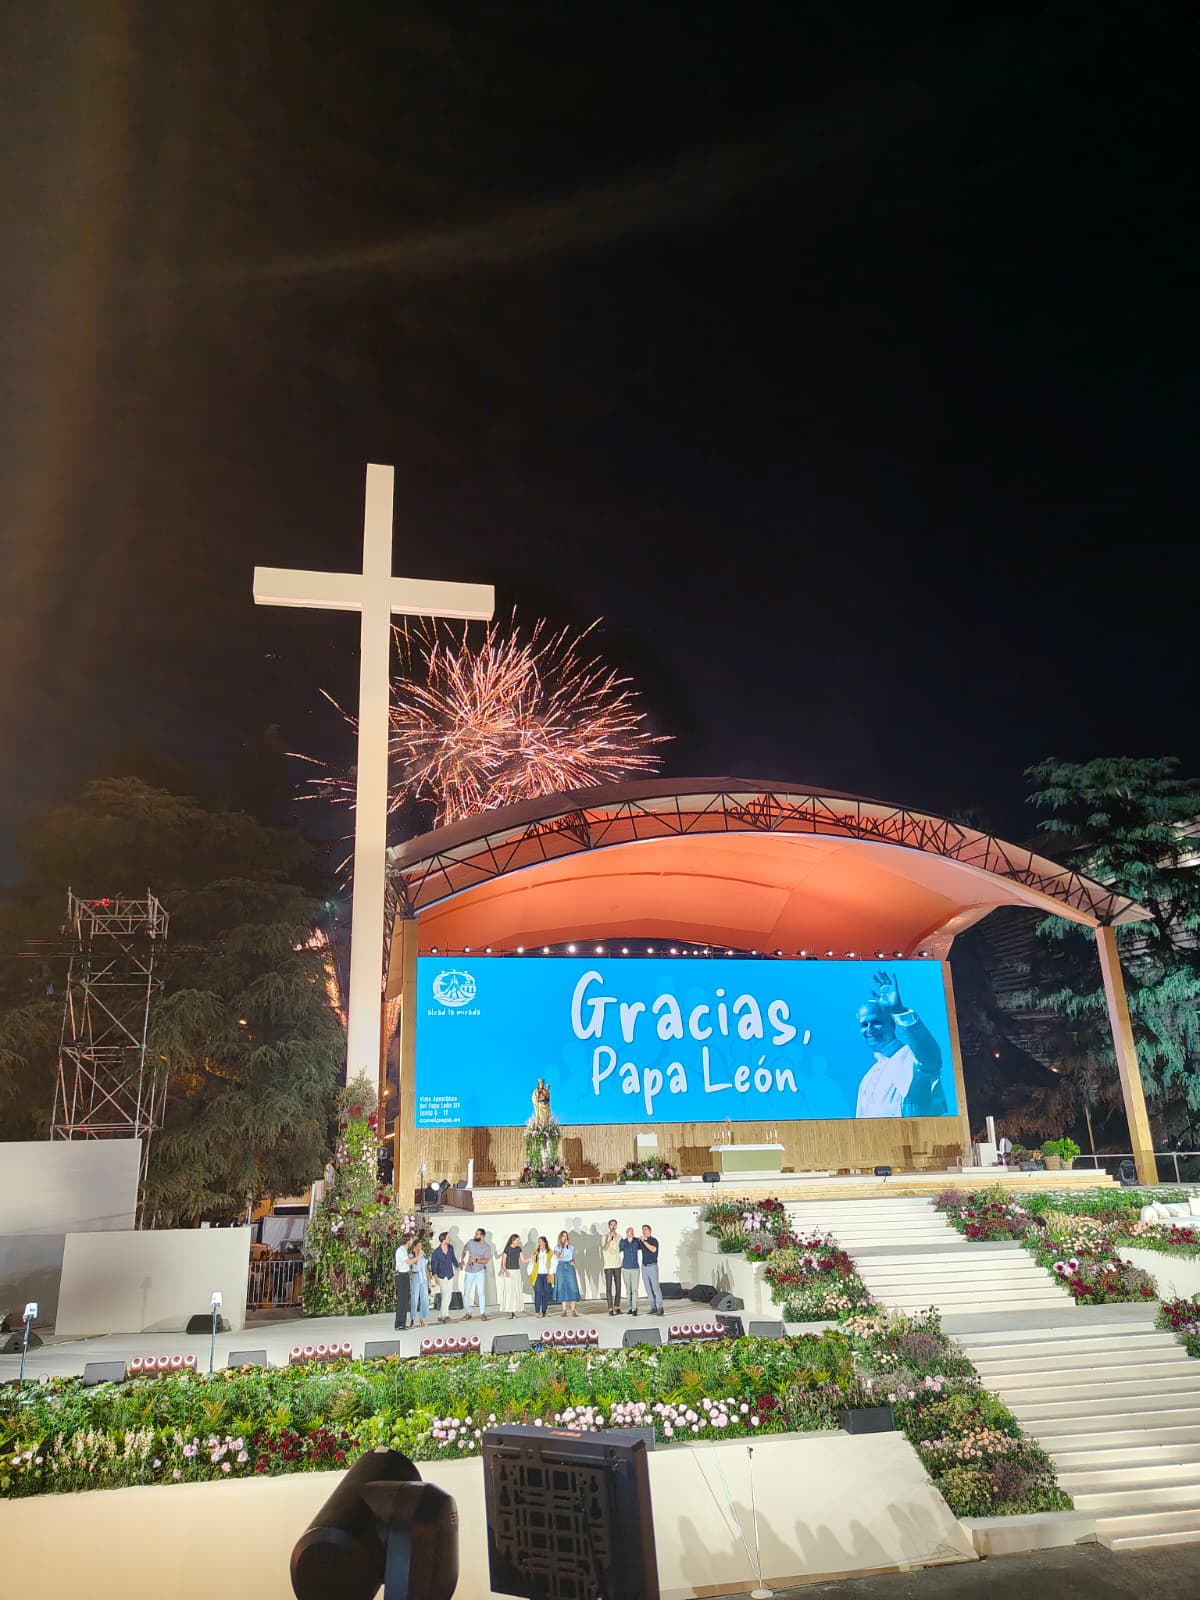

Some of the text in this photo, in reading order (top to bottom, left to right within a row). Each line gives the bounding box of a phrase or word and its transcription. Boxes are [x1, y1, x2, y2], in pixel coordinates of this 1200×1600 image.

[427, 1008, 481, 1016] alzad la mirada
[571, 970, 812, 1046] Gracias,
[591, 1045, 798, 1115] Papa León
